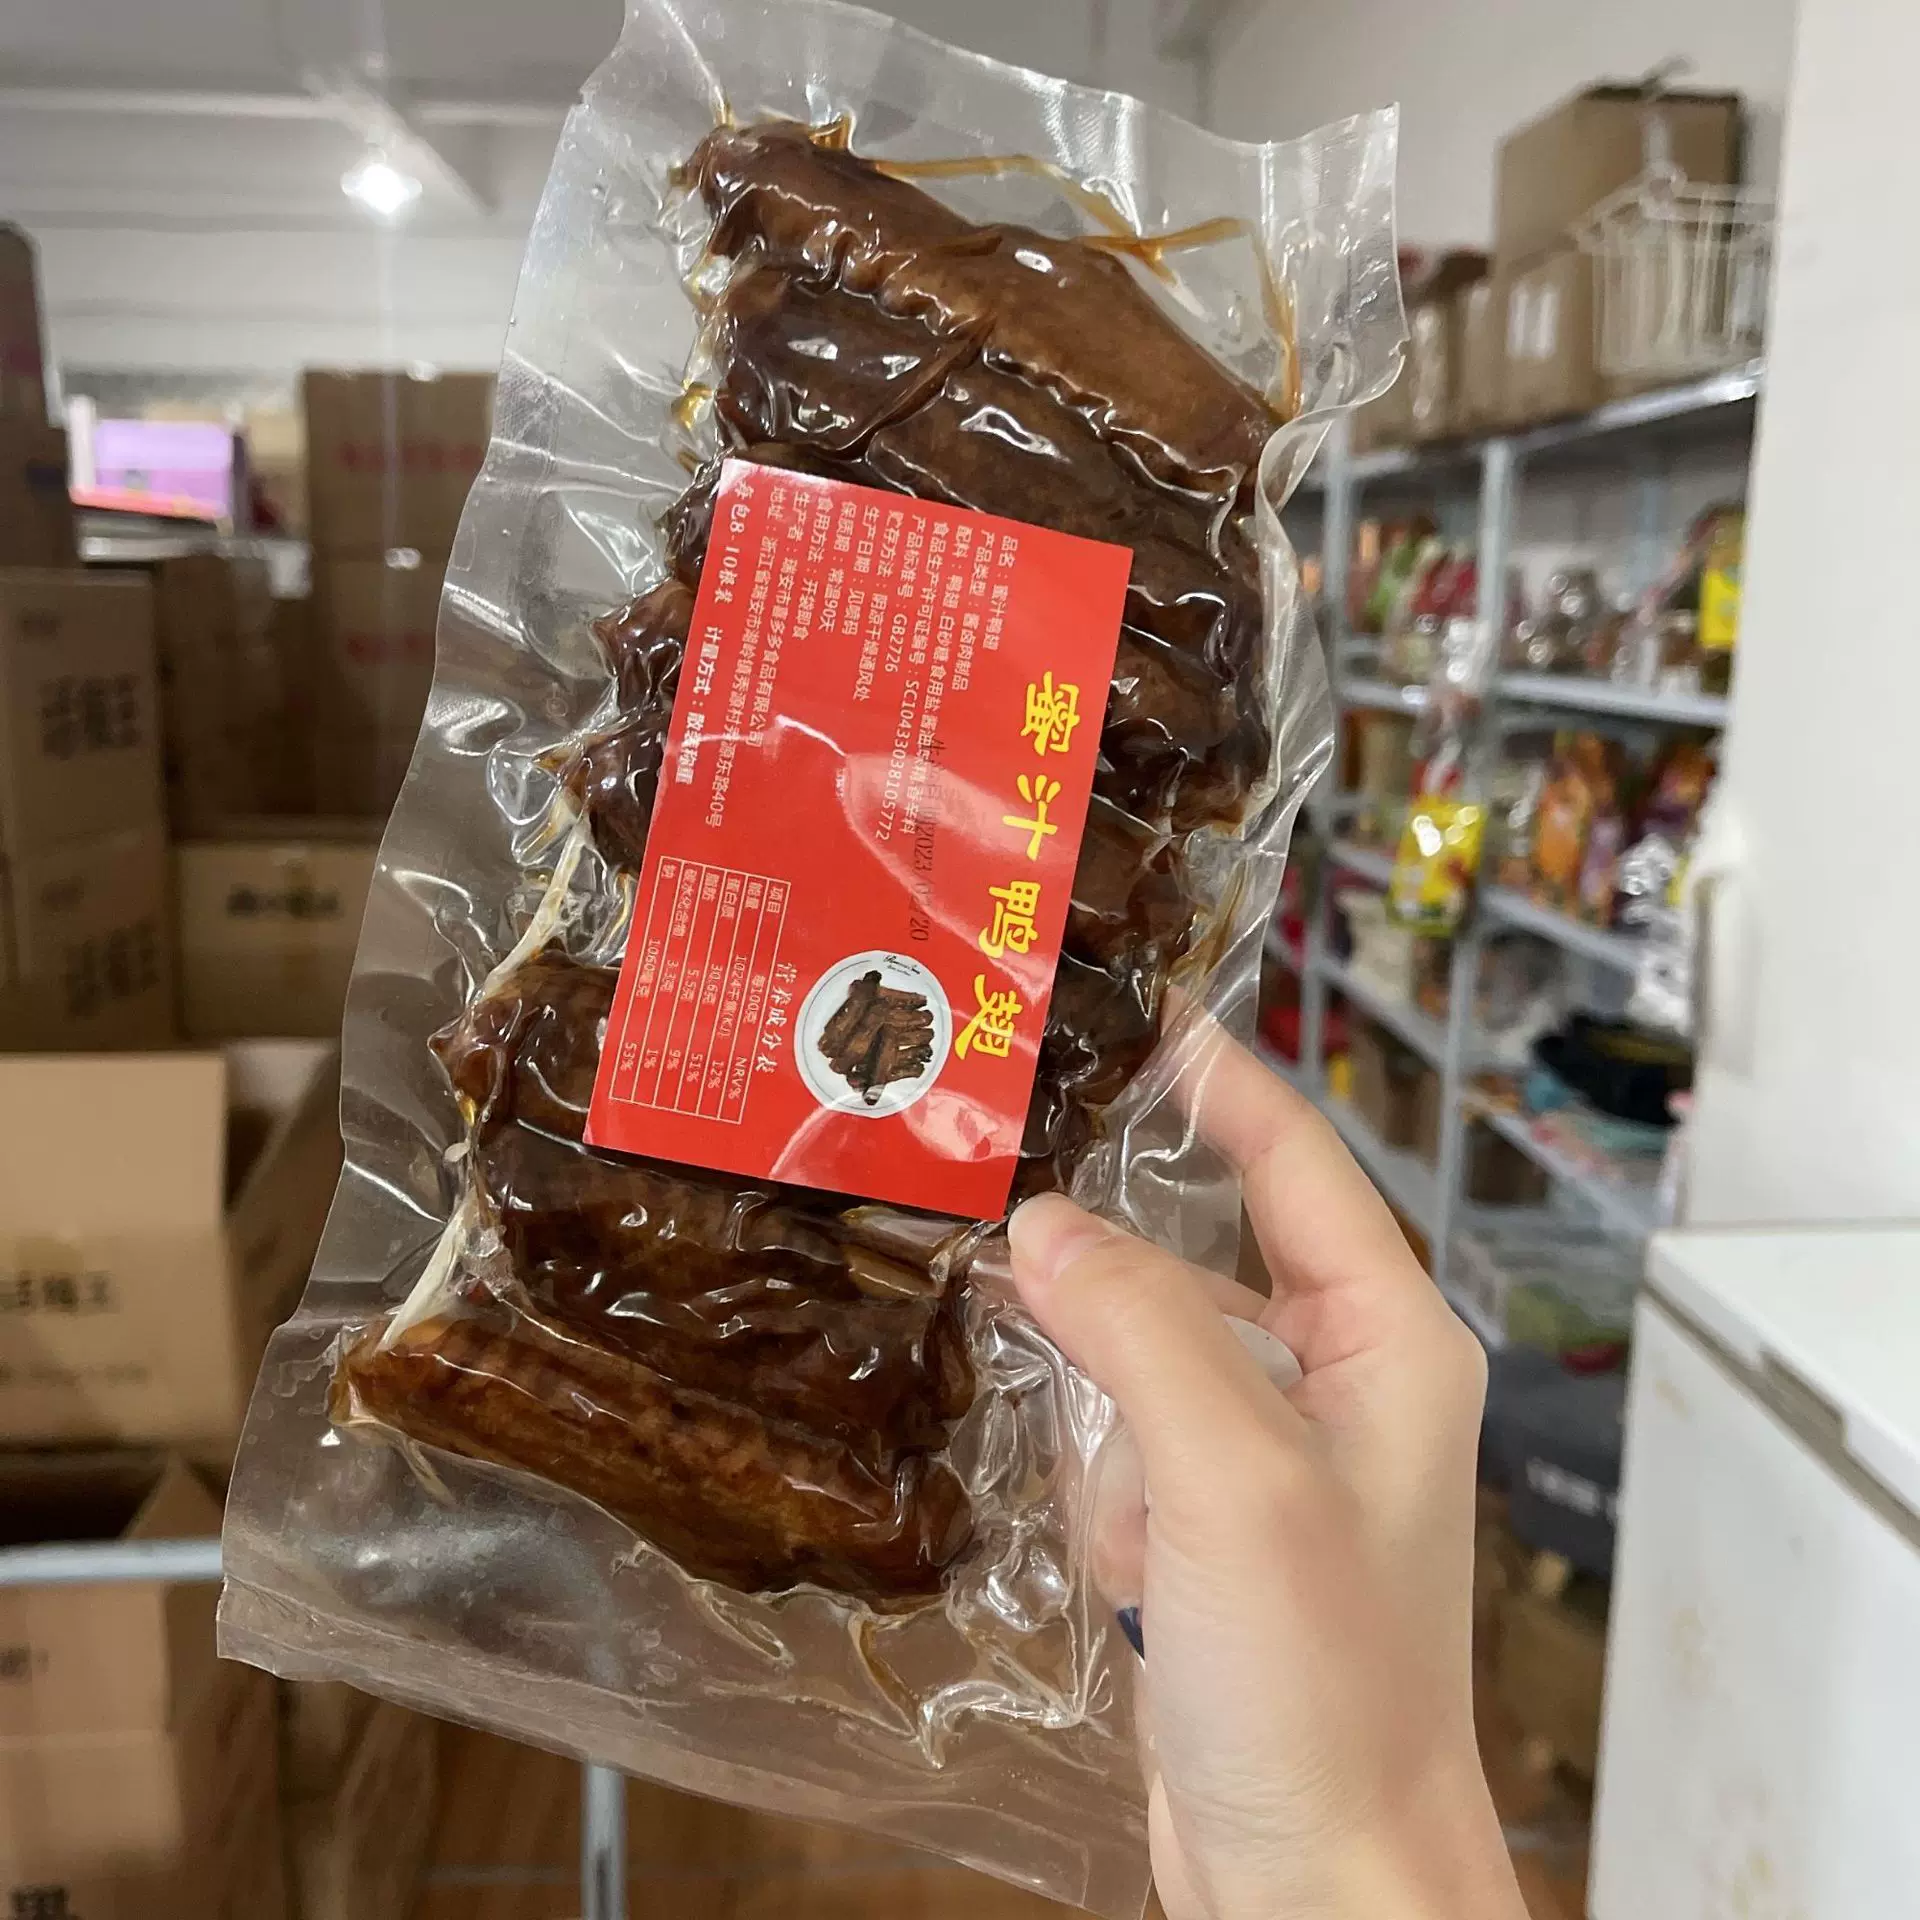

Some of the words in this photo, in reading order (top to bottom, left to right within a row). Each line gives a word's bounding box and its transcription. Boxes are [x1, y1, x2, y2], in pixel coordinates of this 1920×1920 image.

[789, 495, 836, 641] 食用方法：开袋即食
[815, 500, 859, 634] 保质期：常温90天
[839, 504, 882, 636] 生产日期：见喷码
[880, 514, 928, 674] 产品标准号：GB2726
[980, 534, 1019, 651] 品名：蜜汁鸭翅
[765, 885, 784, 914] 项目
[956, 672, 1079, 1057] 蜜汁鸭翅
[619, 1040, 638, 1072] 53%
[754, 960, 797, 1074] 营养成分表
[642, 1046, 659, 1069] 1%
[665, 1048, 682, 1071] 9%
[685, 1051, 703, 1083] 51%
[706, 1059, 724, 1089] 12%
[727, 1055, 748, 1100] NRV%
